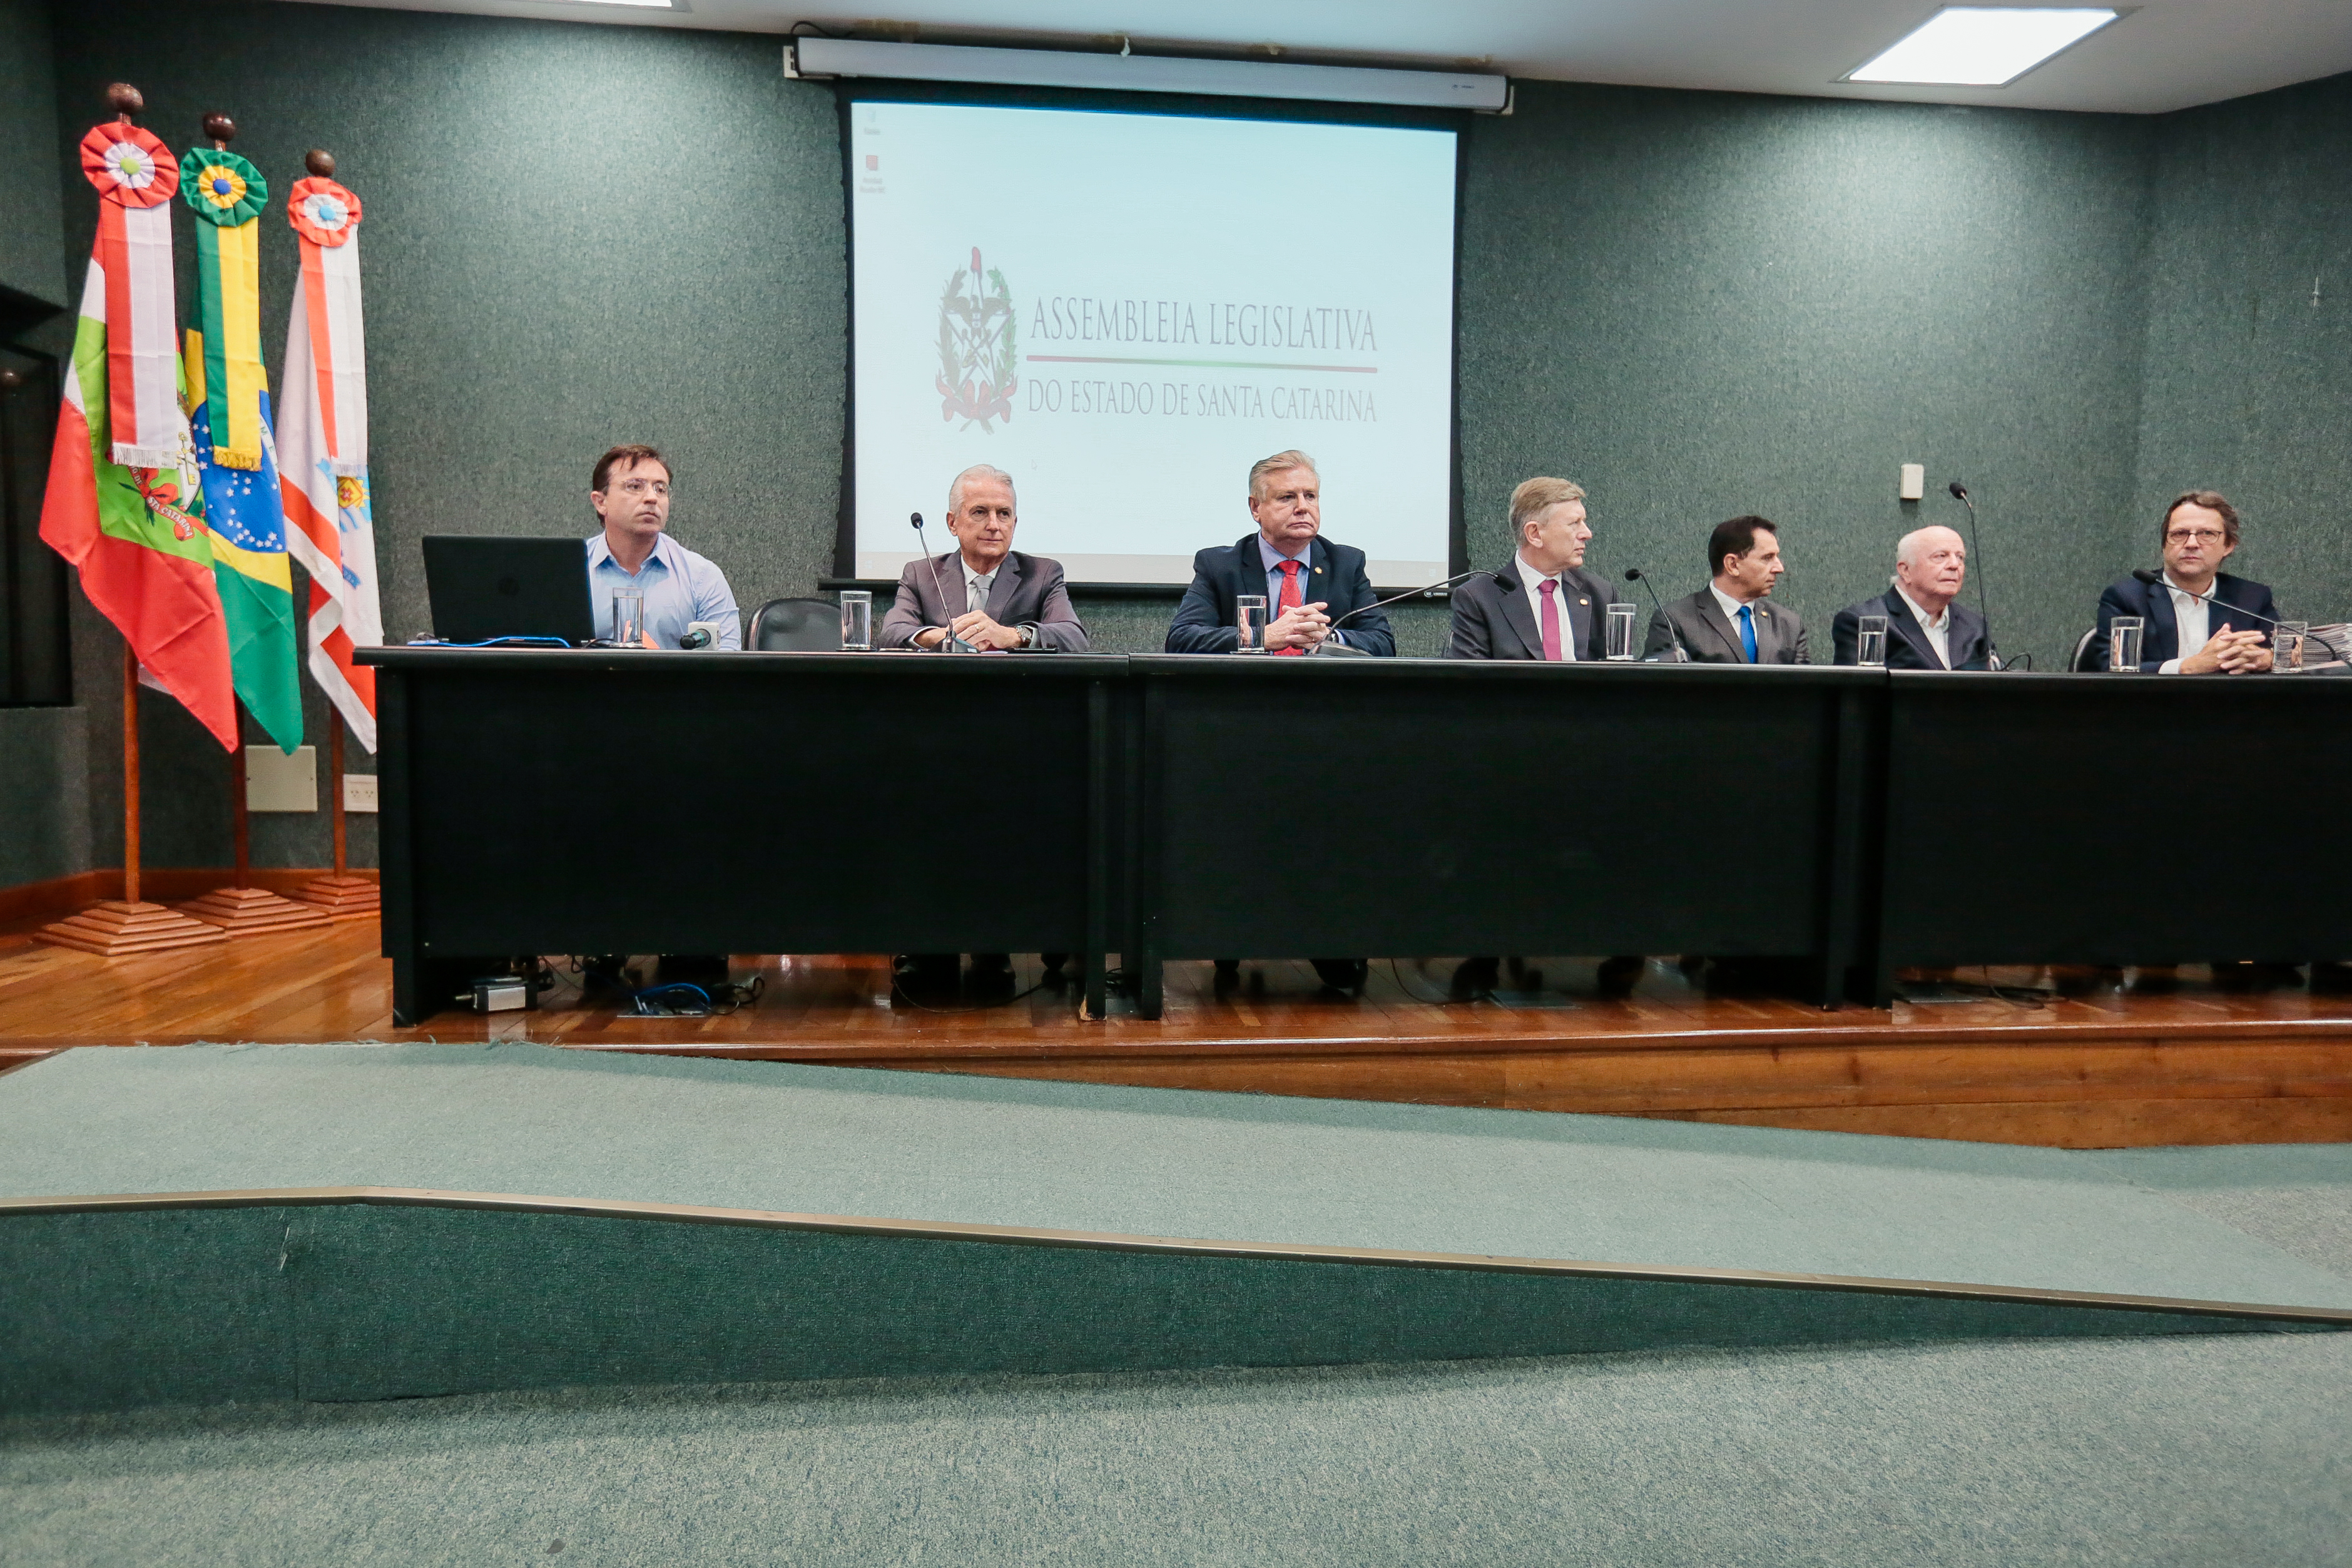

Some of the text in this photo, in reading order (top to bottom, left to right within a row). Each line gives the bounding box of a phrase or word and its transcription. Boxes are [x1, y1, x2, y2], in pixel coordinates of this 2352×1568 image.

[1029, 297, 1378, 351] ASSEMBLEIA LEGISLATIVA
[1028, 379, 1377, 422] DO ESTADO DE SANTA CATARINA
